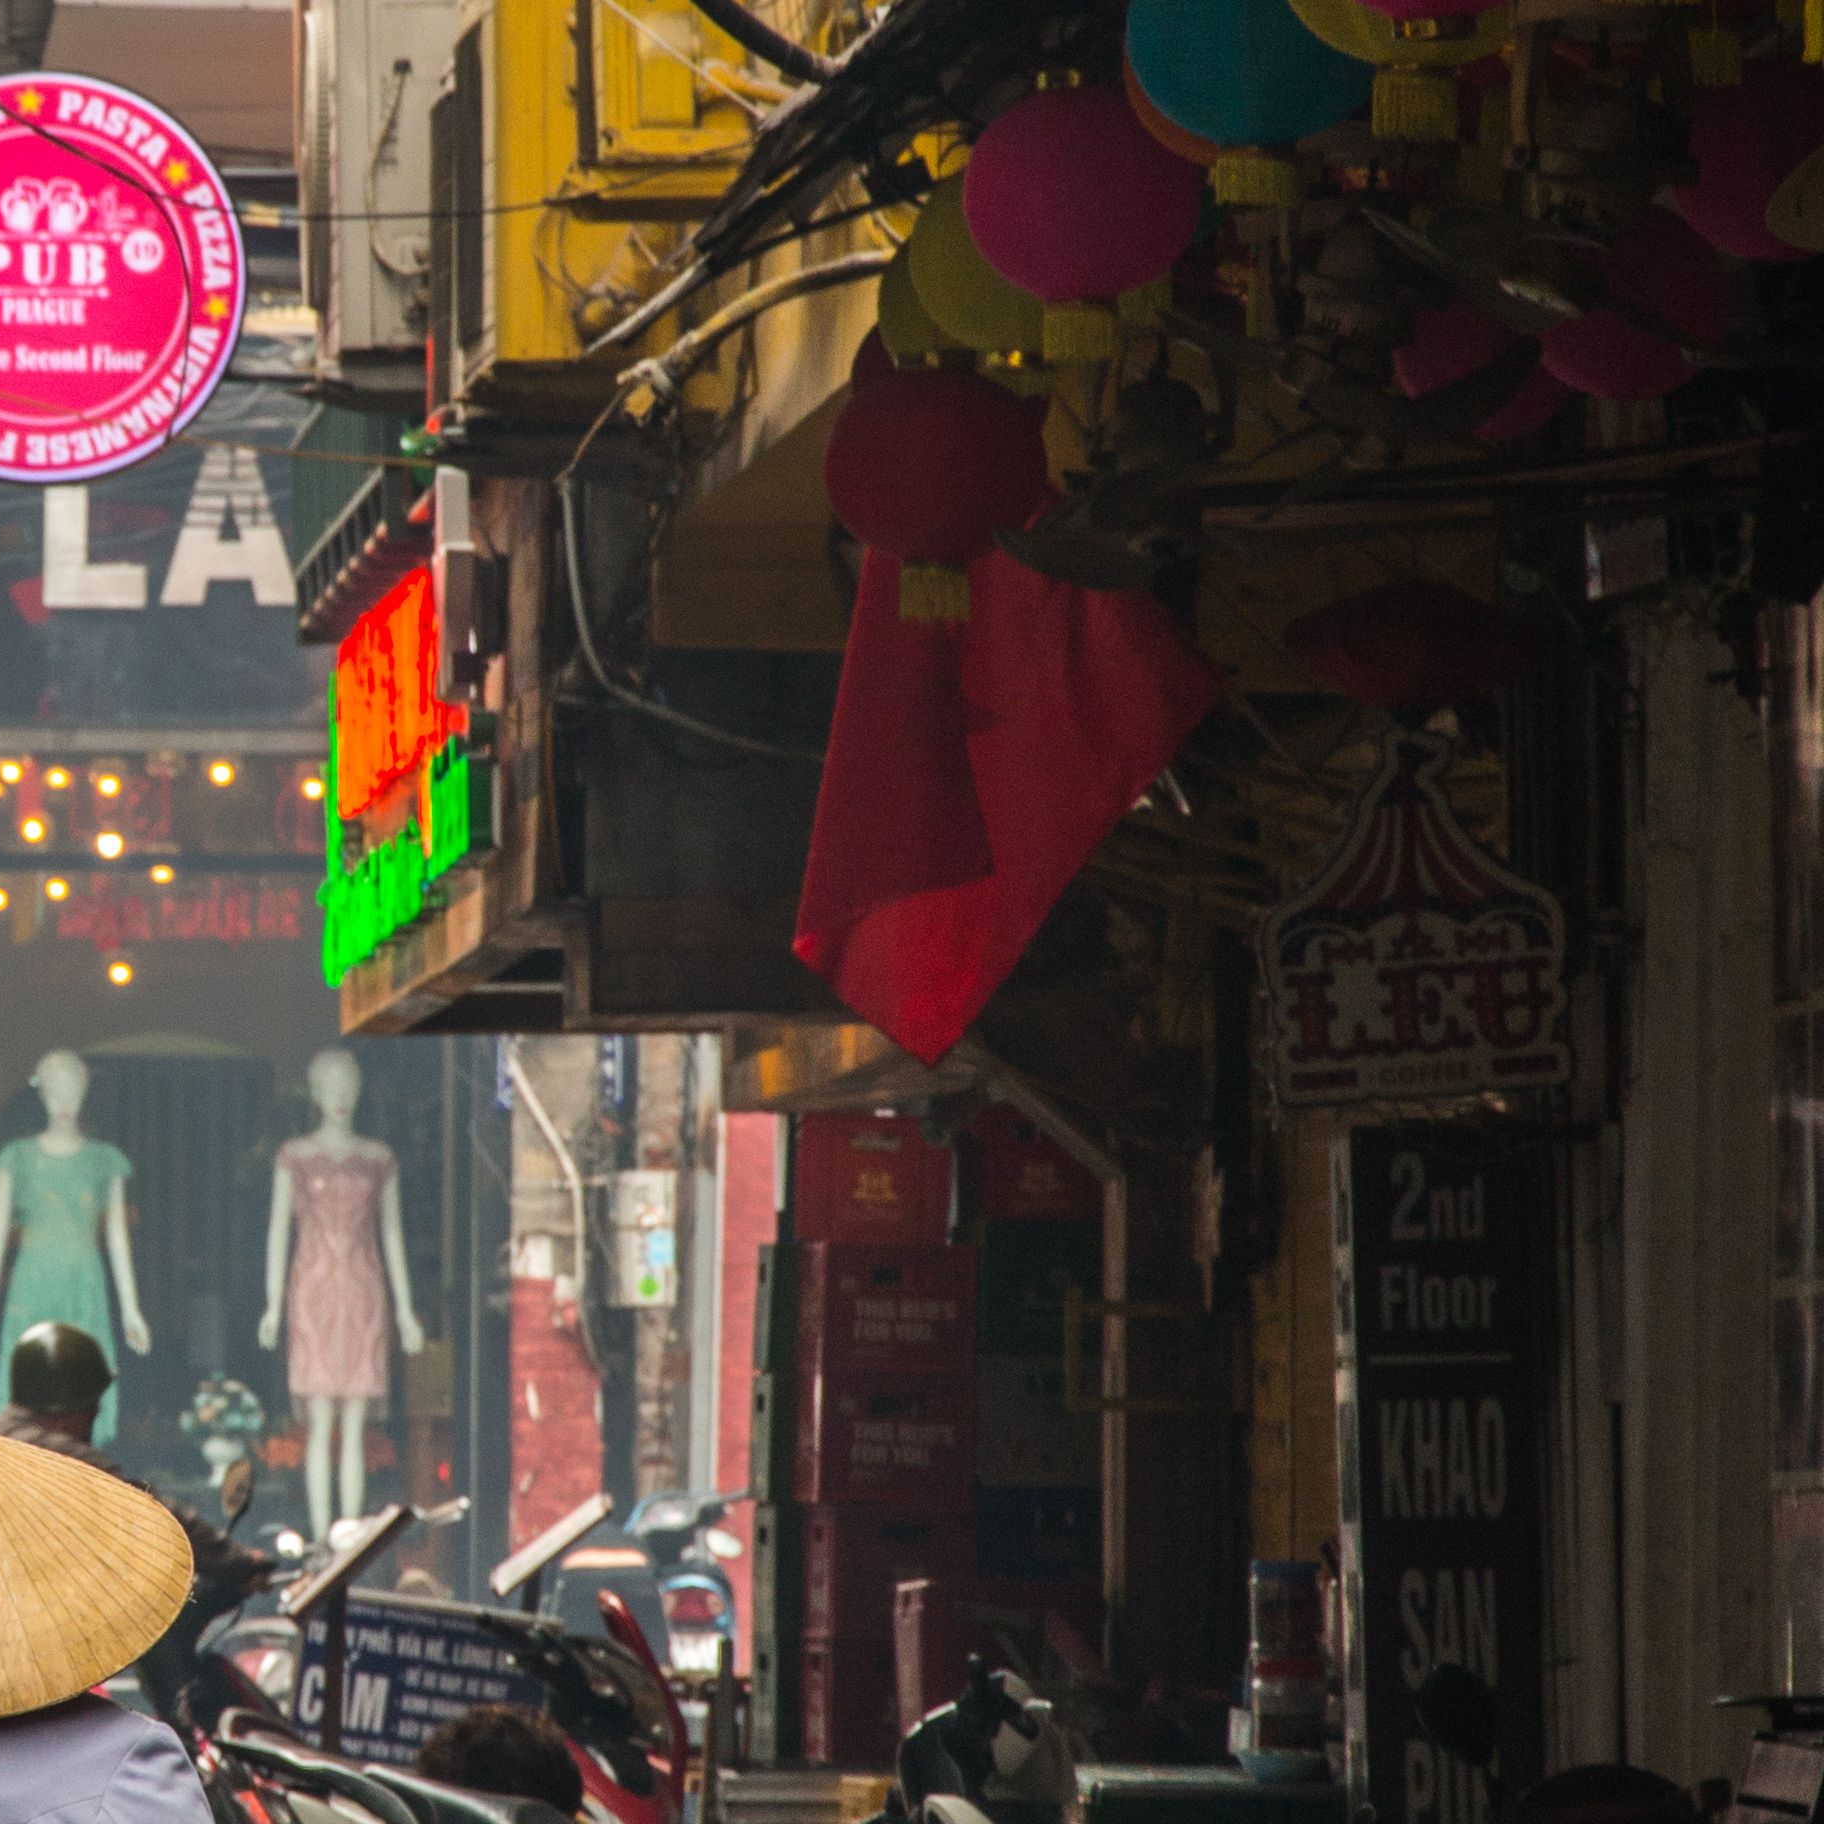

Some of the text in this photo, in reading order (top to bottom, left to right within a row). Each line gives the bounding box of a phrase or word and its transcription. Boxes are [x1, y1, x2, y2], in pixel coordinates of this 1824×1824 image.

[57, 89, 169, 168] PASTA
[184, 181, 233, 292] PIZZA
[2, 297, 87, 325] PRAGUE
[15, 343, 87, 373] Second
[92, 344, 147, 373] Floor
[1388, 1150, 1486, 1243] 2nd
[1380, 1263, 1497, 1334] Floor
[1380, 1398, 1509, 1520] KHAO
[1400, 1567, 1499, 1693] SAN
